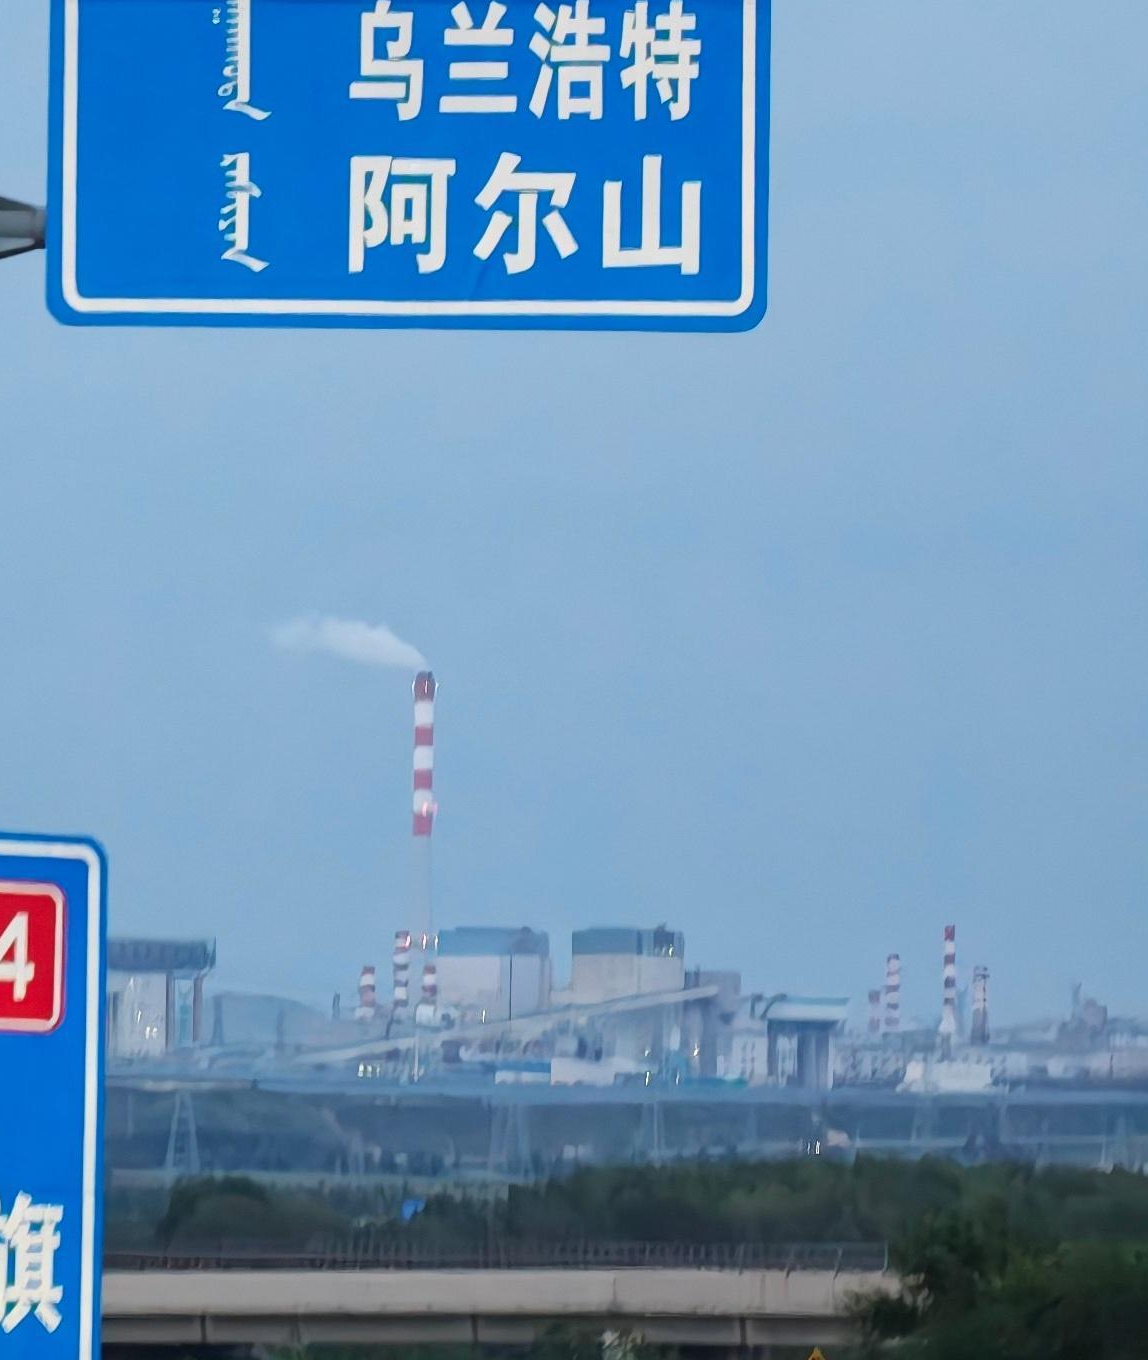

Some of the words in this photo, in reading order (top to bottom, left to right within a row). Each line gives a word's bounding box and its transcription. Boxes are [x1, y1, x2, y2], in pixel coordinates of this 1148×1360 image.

[349, 0, 702, 121] 乌兰浩特
[348, 151, 702, 275] 阿尔山
